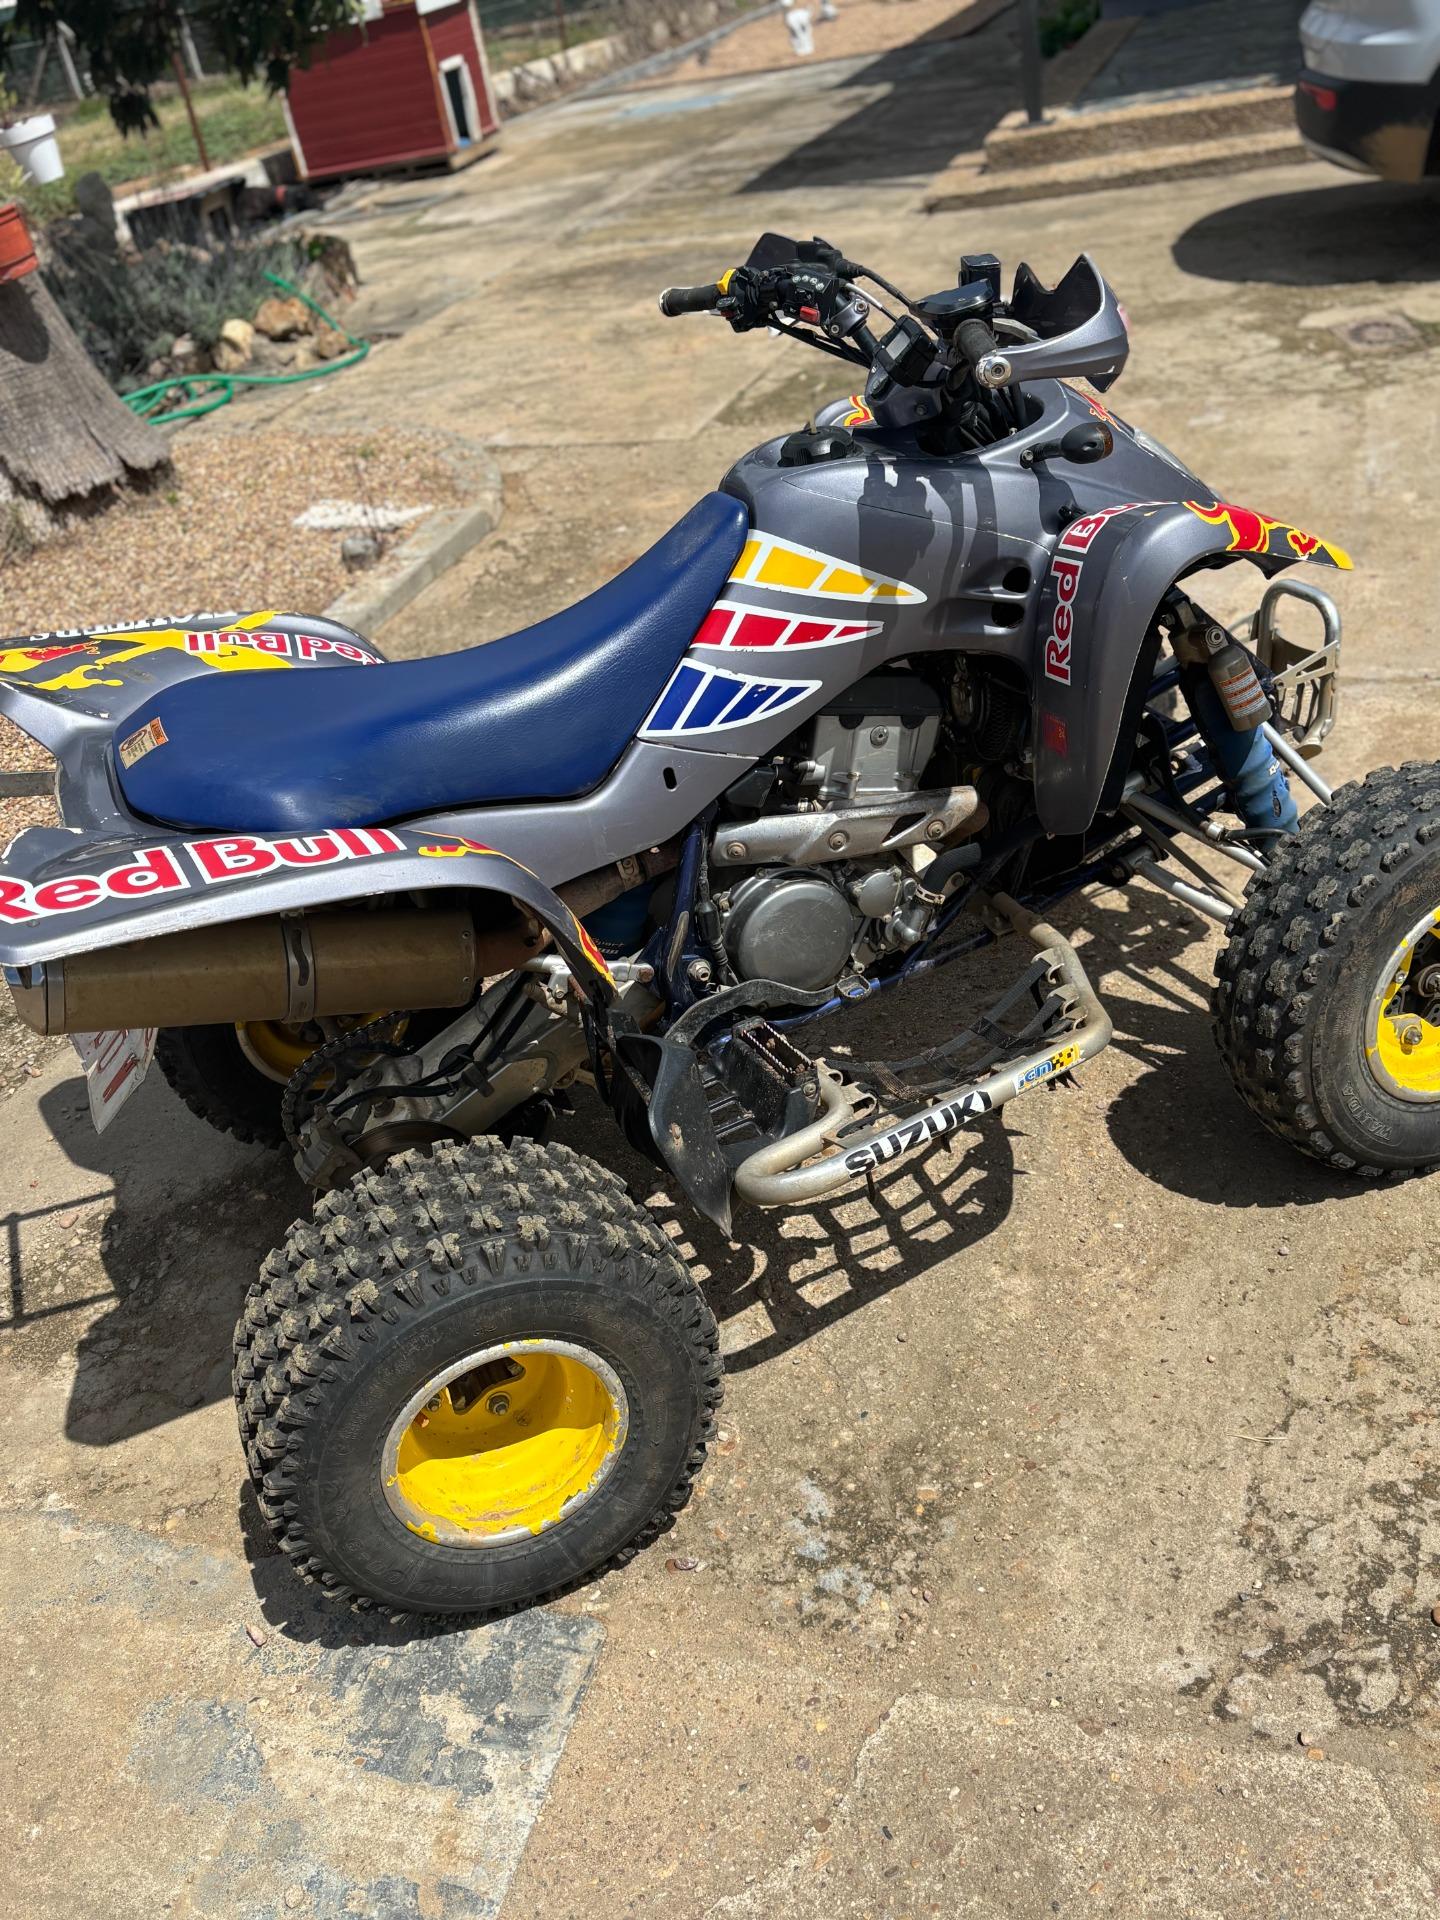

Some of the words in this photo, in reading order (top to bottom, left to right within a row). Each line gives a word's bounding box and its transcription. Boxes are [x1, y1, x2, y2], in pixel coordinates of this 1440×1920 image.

[1058, 502, 1178, 554] Bu
[184, 631, 292, 657] Bull
[1045, 555, 1084, 686] Red
[182, 828, 408, 884] Bull
[845, 1091, 993, 1179] SUZUKI
